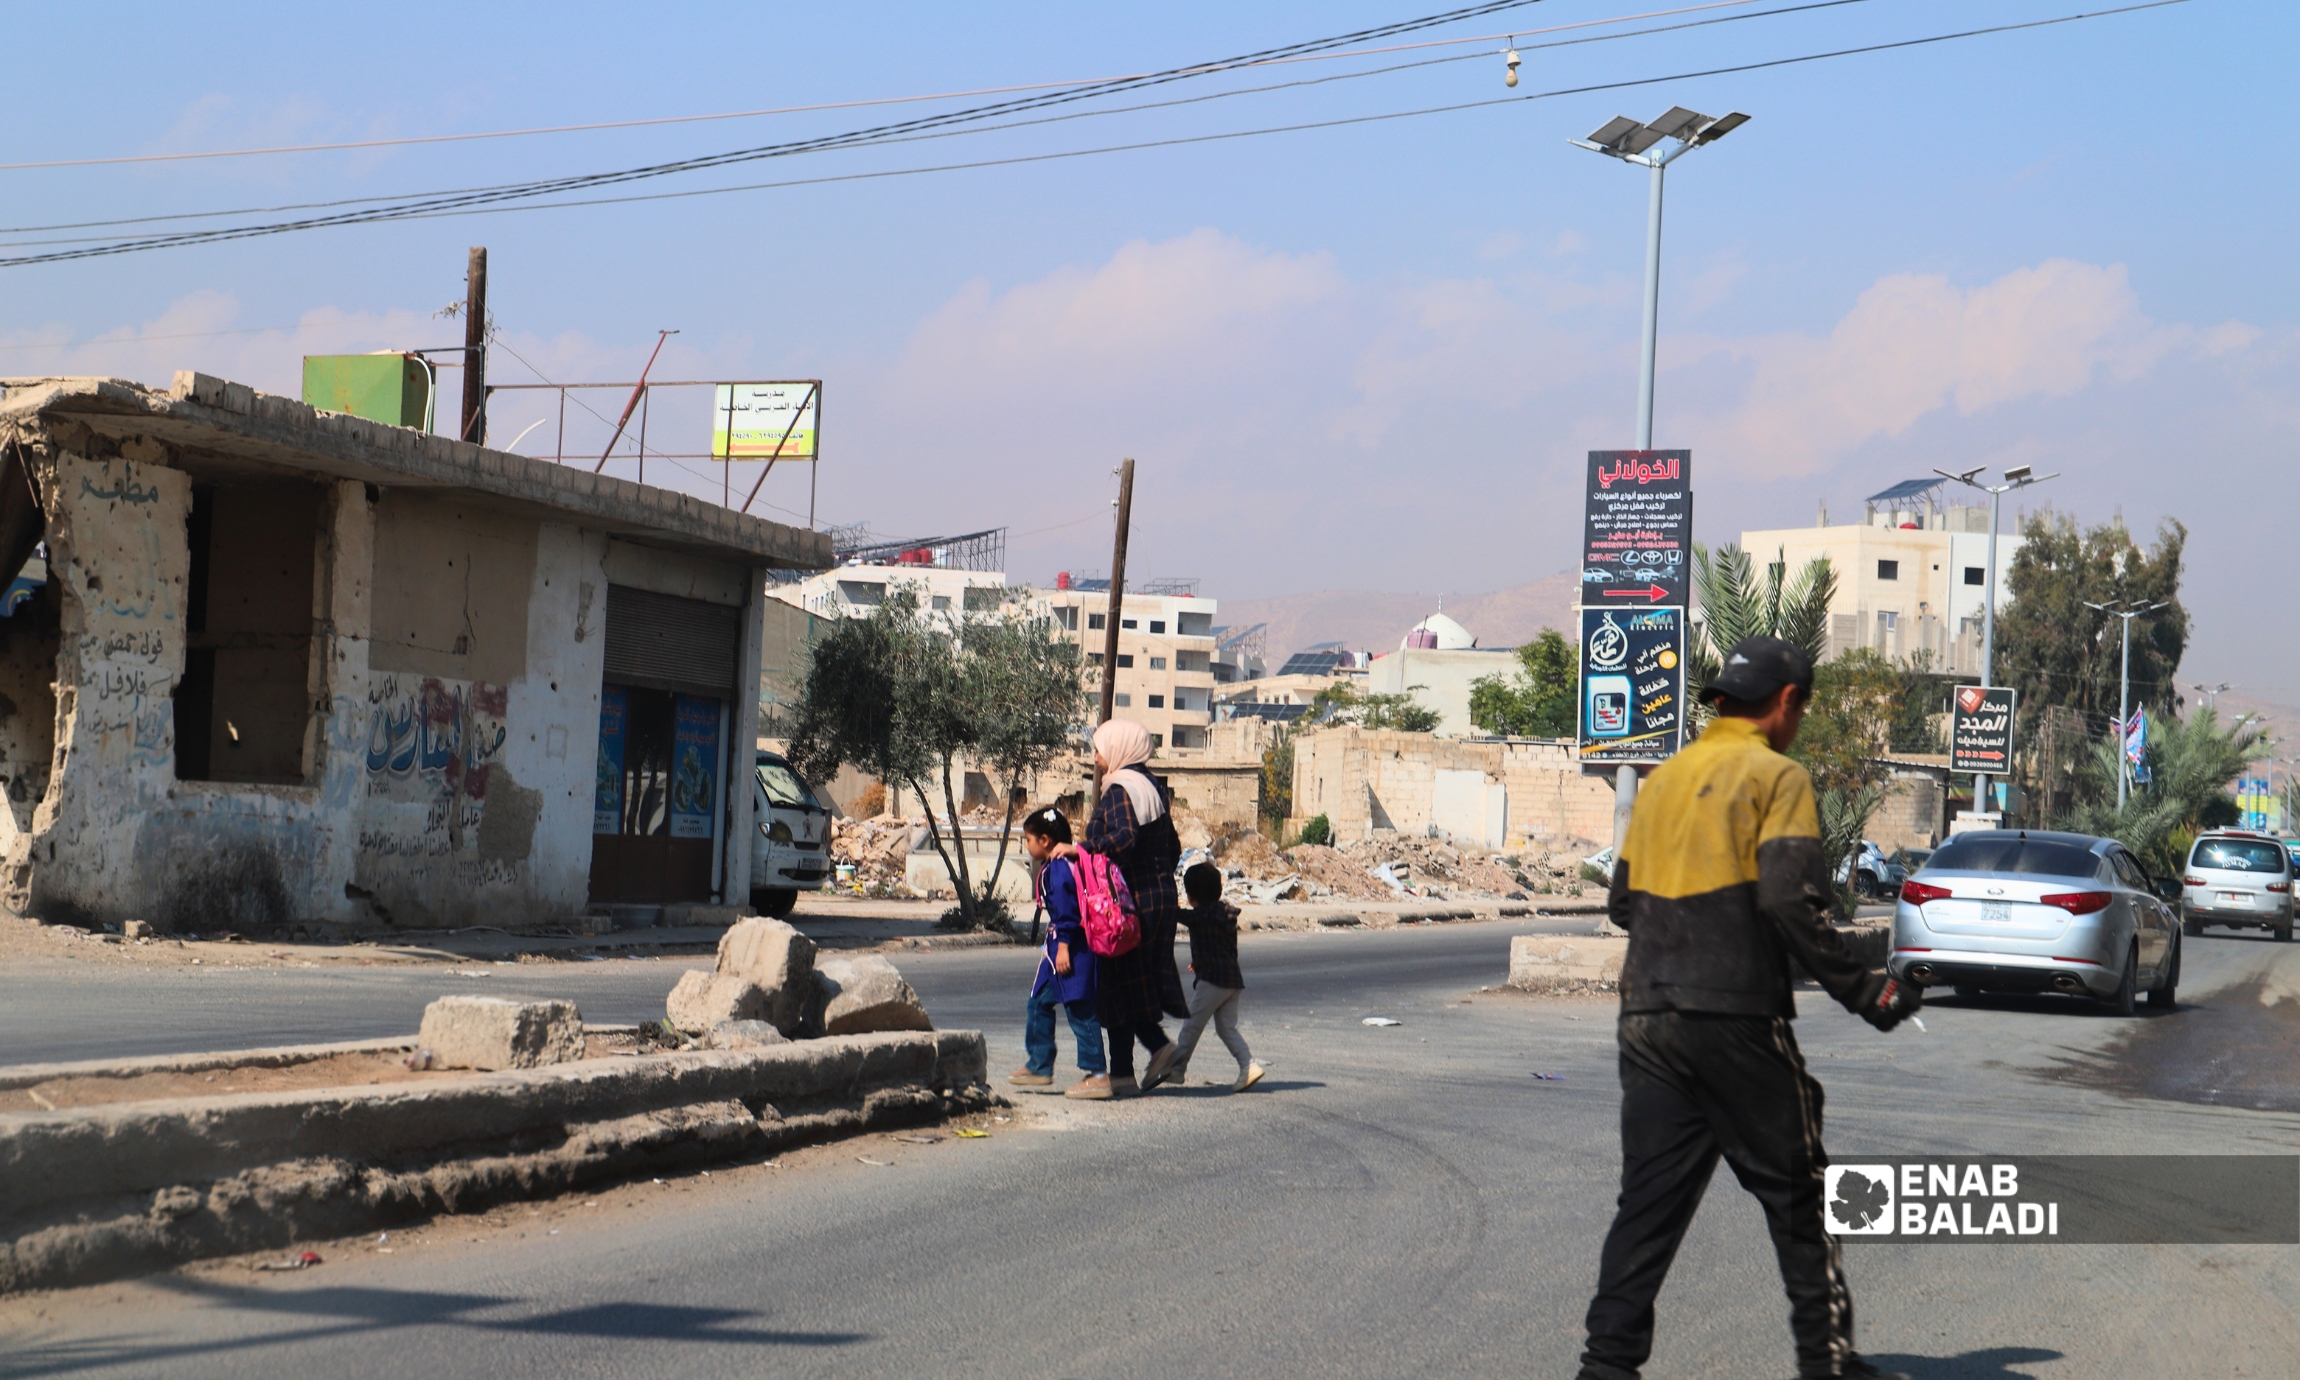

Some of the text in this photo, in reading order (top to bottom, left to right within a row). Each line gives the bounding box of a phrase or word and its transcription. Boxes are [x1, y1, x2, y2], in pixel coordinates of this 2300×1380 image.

[1598, 458, 1679, 489] الخولاني
[1593, 491, 1619, 500] السيارات
[1637, 492, 1654, 501] جميع
[1588, 553, 1620, 562] GMC
[1634, 661, 1659, 675] مرحلة
[100, 666, 147, 699] فلافل
[1638, 677, 1670, 696] كفالة
[1641, 694, 1672, 715] عامين
[1979, 700, 2008, 713] مركز
[1959, 715, 2008, 735] المجد
[1957, 735, 2005, 747] للسيراميك
